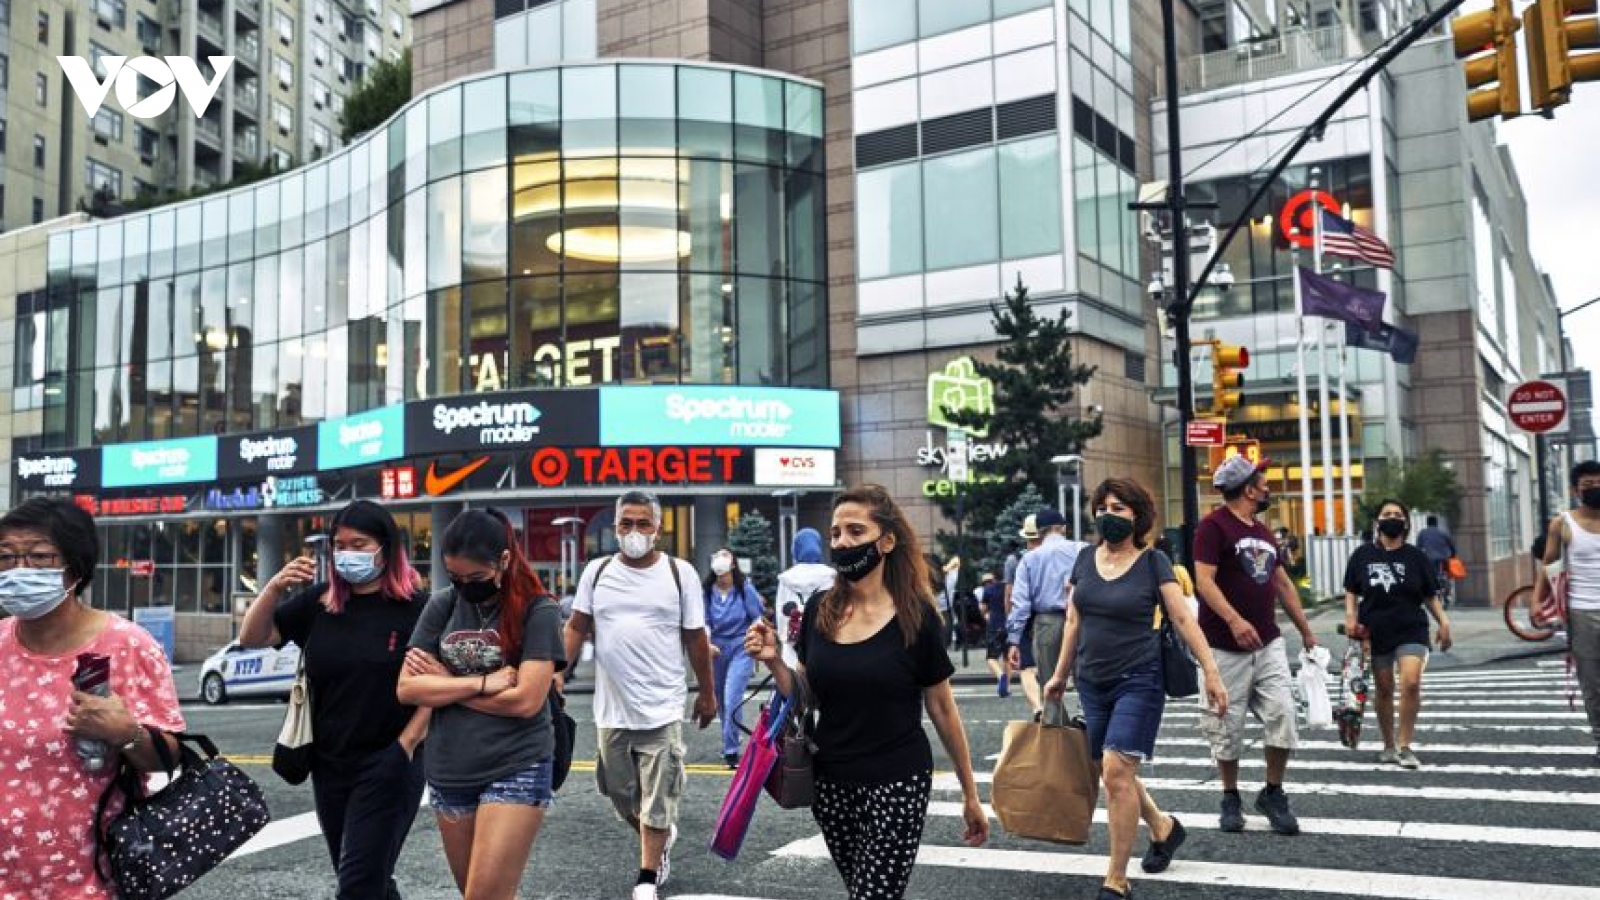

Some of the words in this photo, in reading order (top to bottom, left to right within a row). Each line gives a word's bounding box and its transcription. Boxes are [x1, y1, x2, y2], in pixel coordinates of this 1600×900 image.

[1516, 391, 1532, 401] DO
[1534, 390, 1555, 400] NOT
[433, 400, 532, 434] Spectrum
[666, 393, 785, 424] Spectrum
[1521, 414, 1554, 424] ENTER
[792, 457, 816, 468] CVS
[917, 430, 1008, 474] skyiew
[574, 448, 742, 482] TARGET
[235, 657, 263, 674] NYPD
